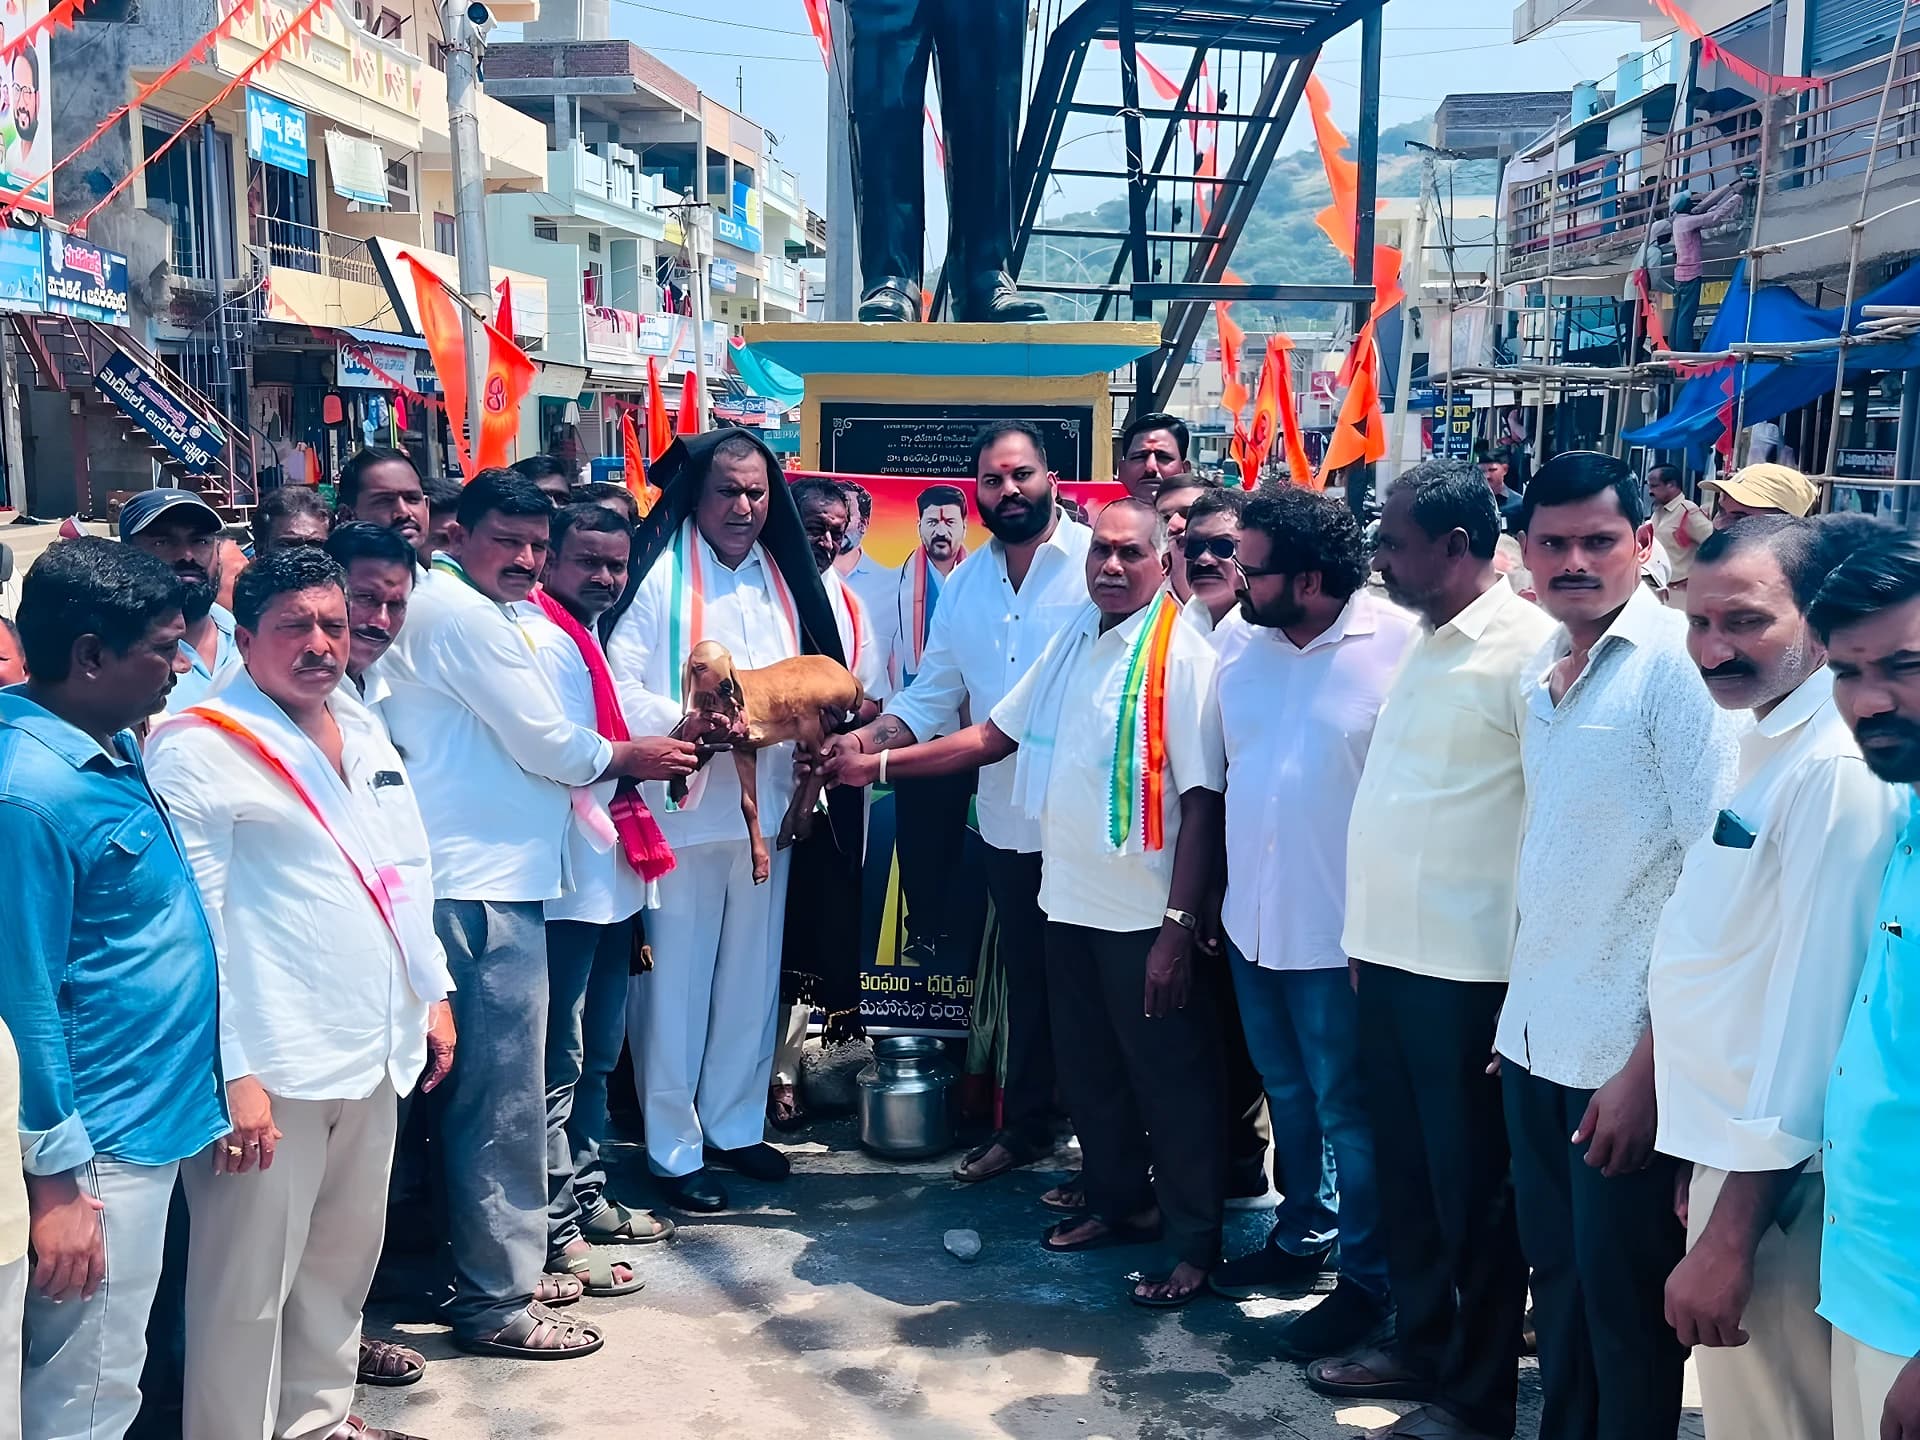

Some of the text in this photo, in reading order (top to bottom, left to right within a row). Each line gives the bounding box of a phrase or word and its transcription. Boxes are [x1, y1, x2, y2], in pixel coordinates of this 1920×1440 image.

[100, 366, 144, 408] మెడికల్
[145, 409, 187, 445] జనరల్
[1435, 405, 1471, 418] SEP
[1453, 421, 1470, 433] UP
[929, 1001, 974, 1026] ధర్మా
